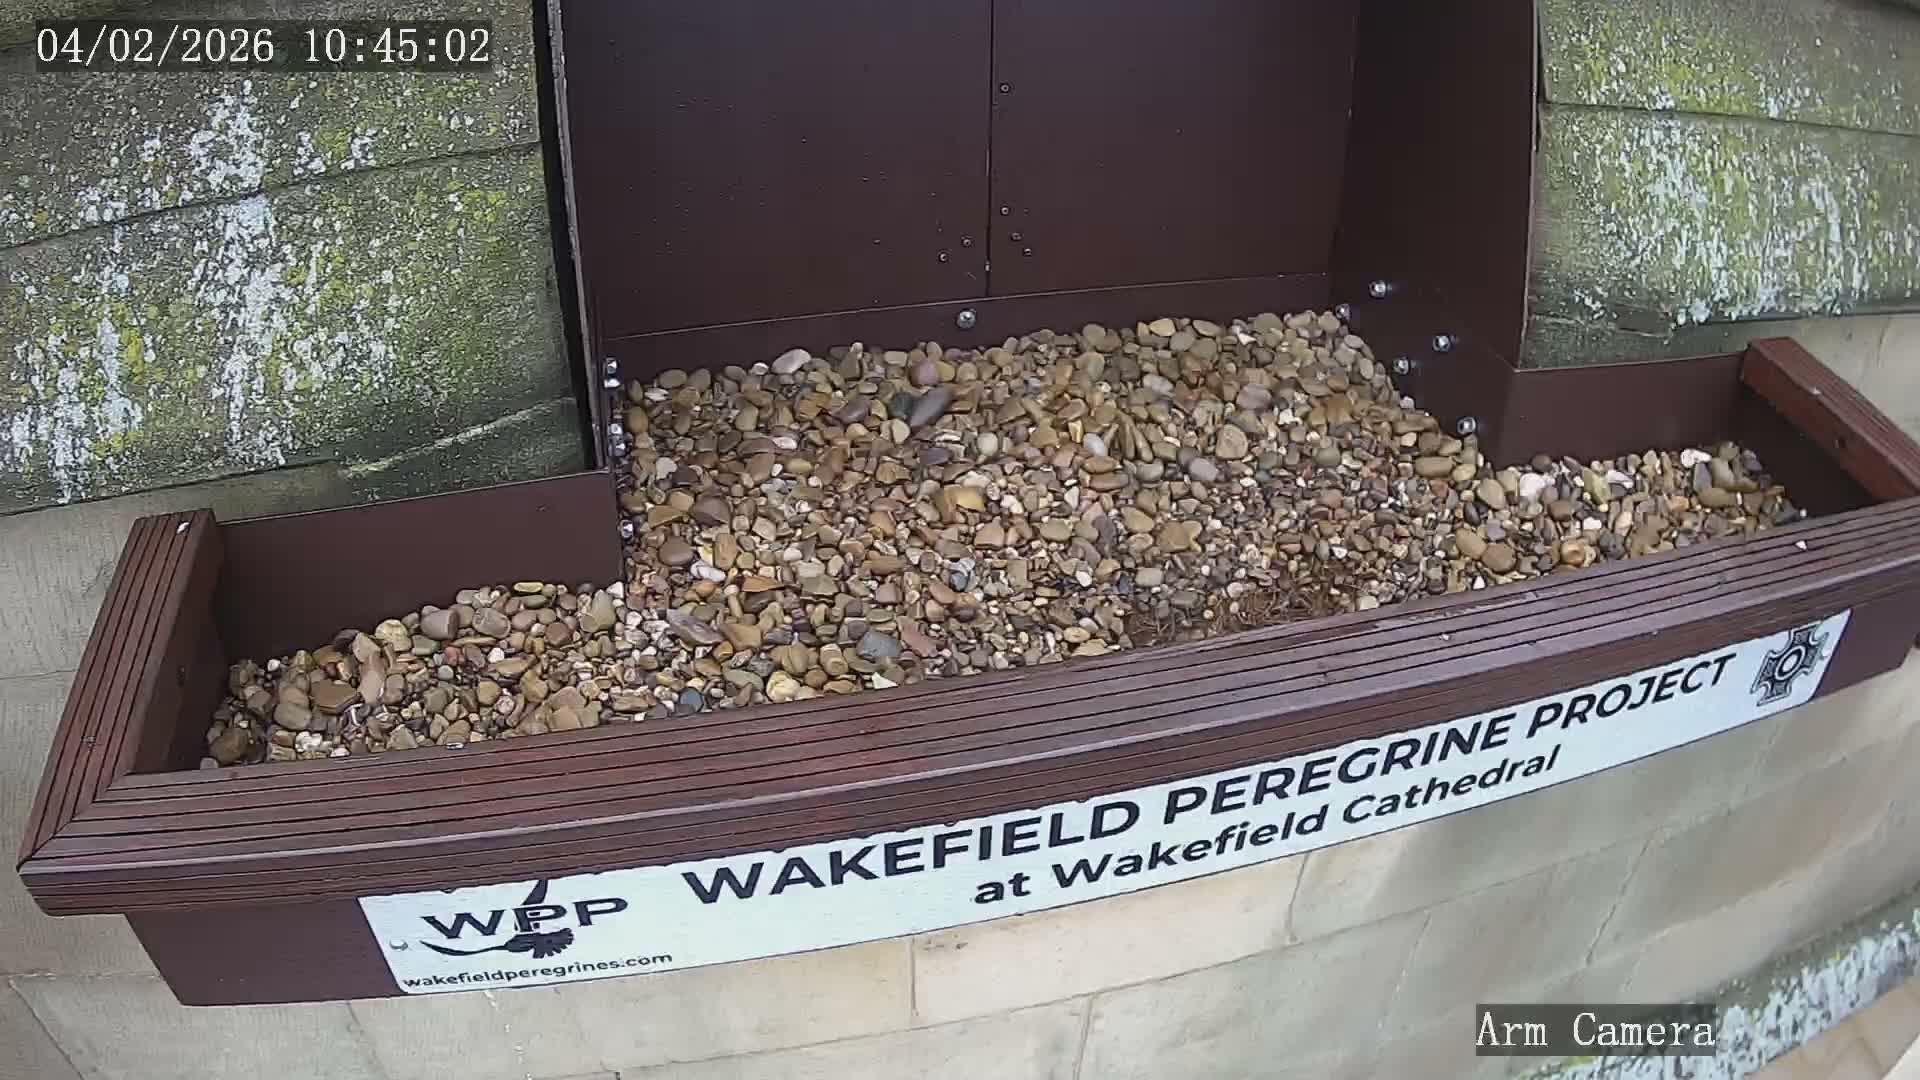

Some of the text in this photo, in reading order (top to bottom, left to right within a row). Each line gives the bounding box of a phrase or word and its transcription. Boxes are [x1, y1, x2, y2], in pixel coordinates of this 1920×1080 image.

[683, 653, 1736, 905] WAKEFIELD PEREGRINE PROJECT
[974, 746, 1560, 905] at Wakefield Cathedral
[421, 897, 628, 939] WPP
[403, 952, 673, 988] wakefieldperegrines.com
